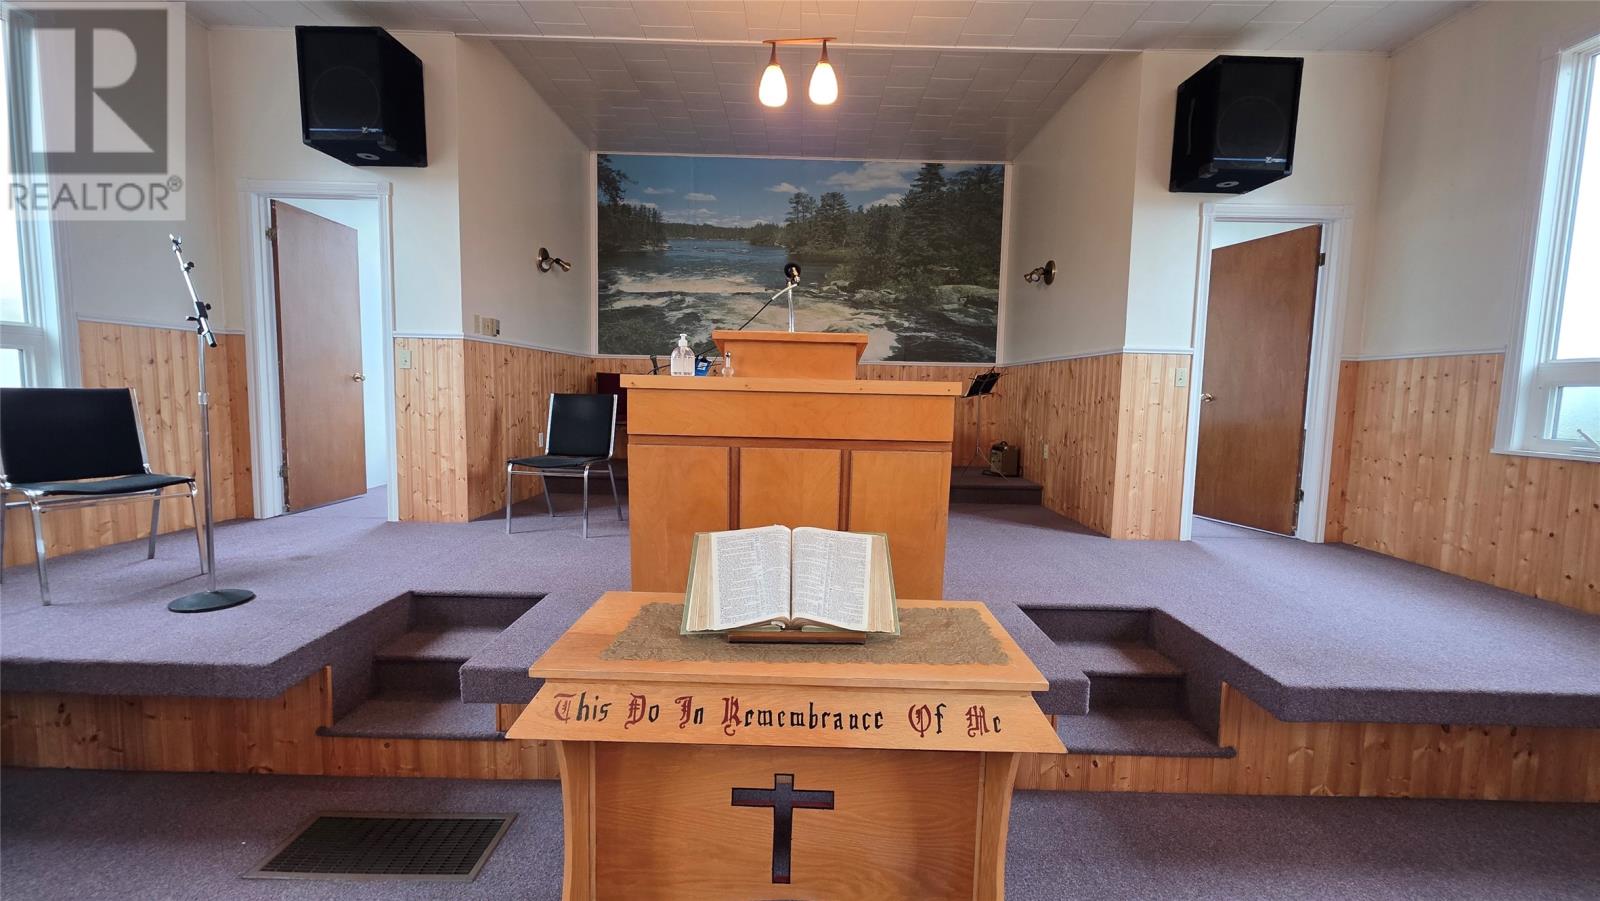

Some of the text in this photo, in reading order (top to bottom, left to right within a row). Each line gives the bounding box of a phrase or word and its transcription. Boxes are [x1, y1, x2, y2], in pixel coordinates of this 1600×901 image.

[553, 691, 1002, 738] This Do In Remembrance Of Me
